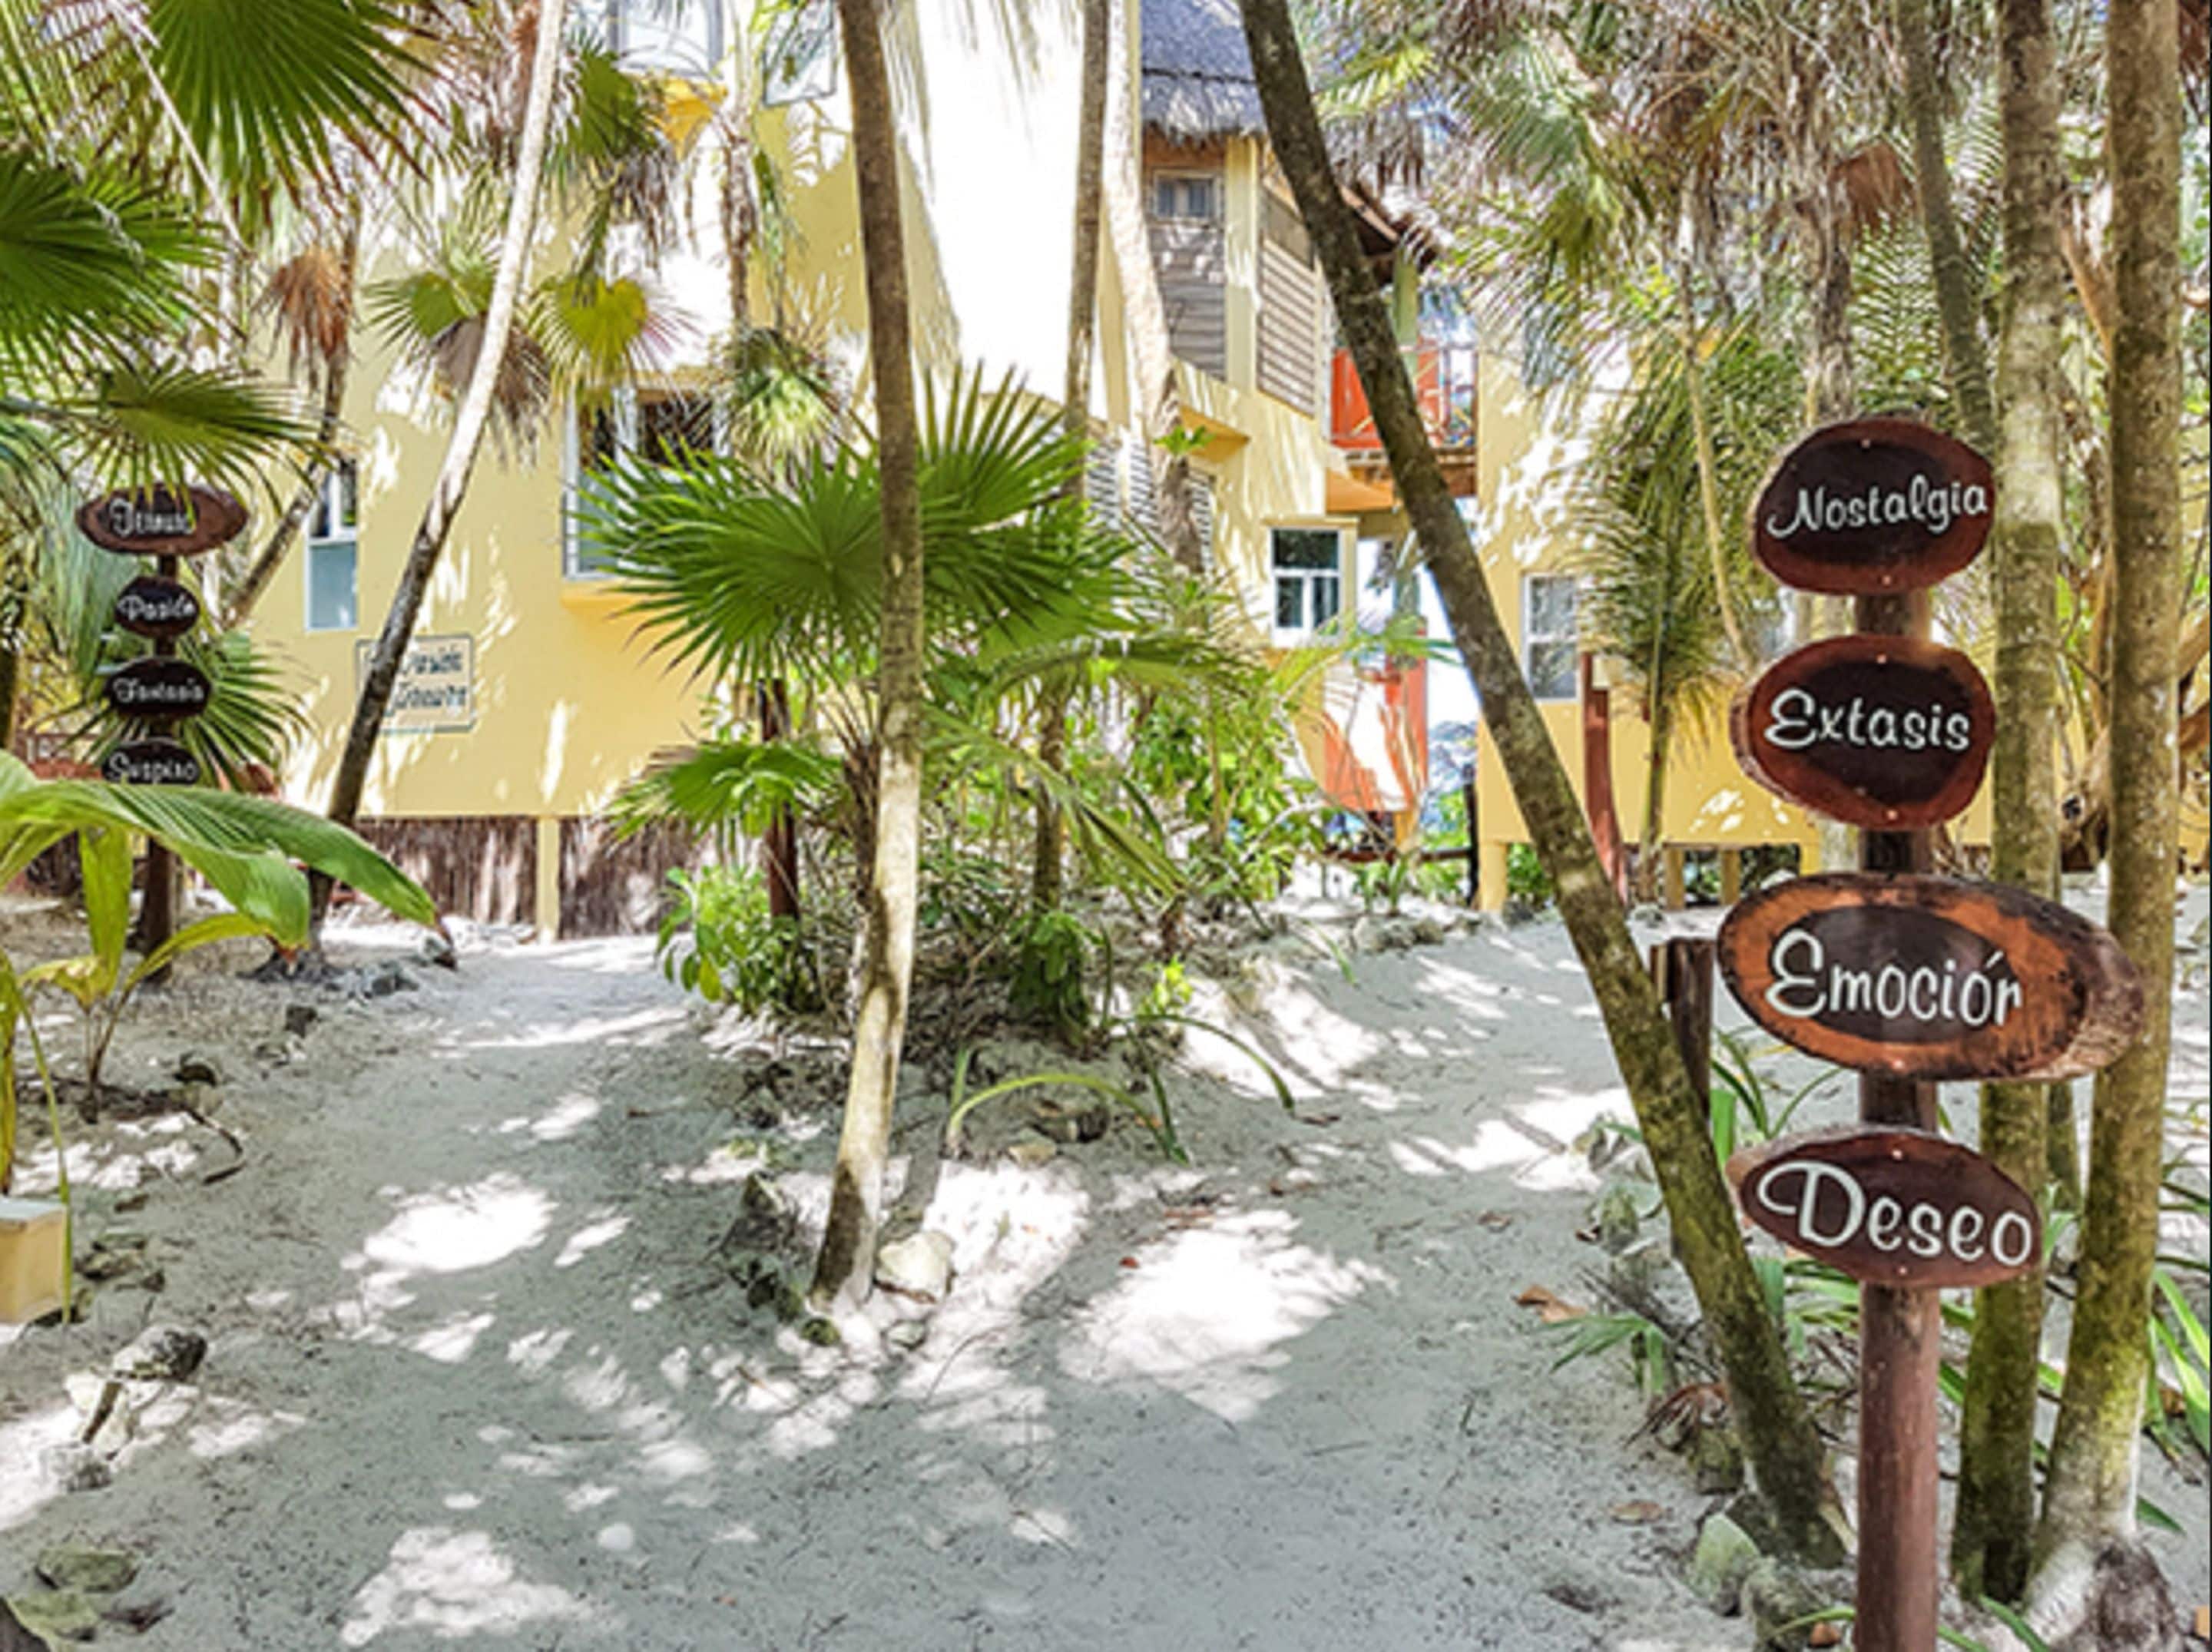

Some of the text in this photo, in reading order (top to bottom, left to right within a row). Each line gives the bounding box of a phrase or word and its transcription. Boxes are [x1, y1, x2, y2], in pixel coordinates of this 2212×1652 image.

[1767, 475, 1987, 538] Nostalgia
[1764, 689, 1971, 750] Extasis
[1757, 1160, 2032, 1266] Deseo
